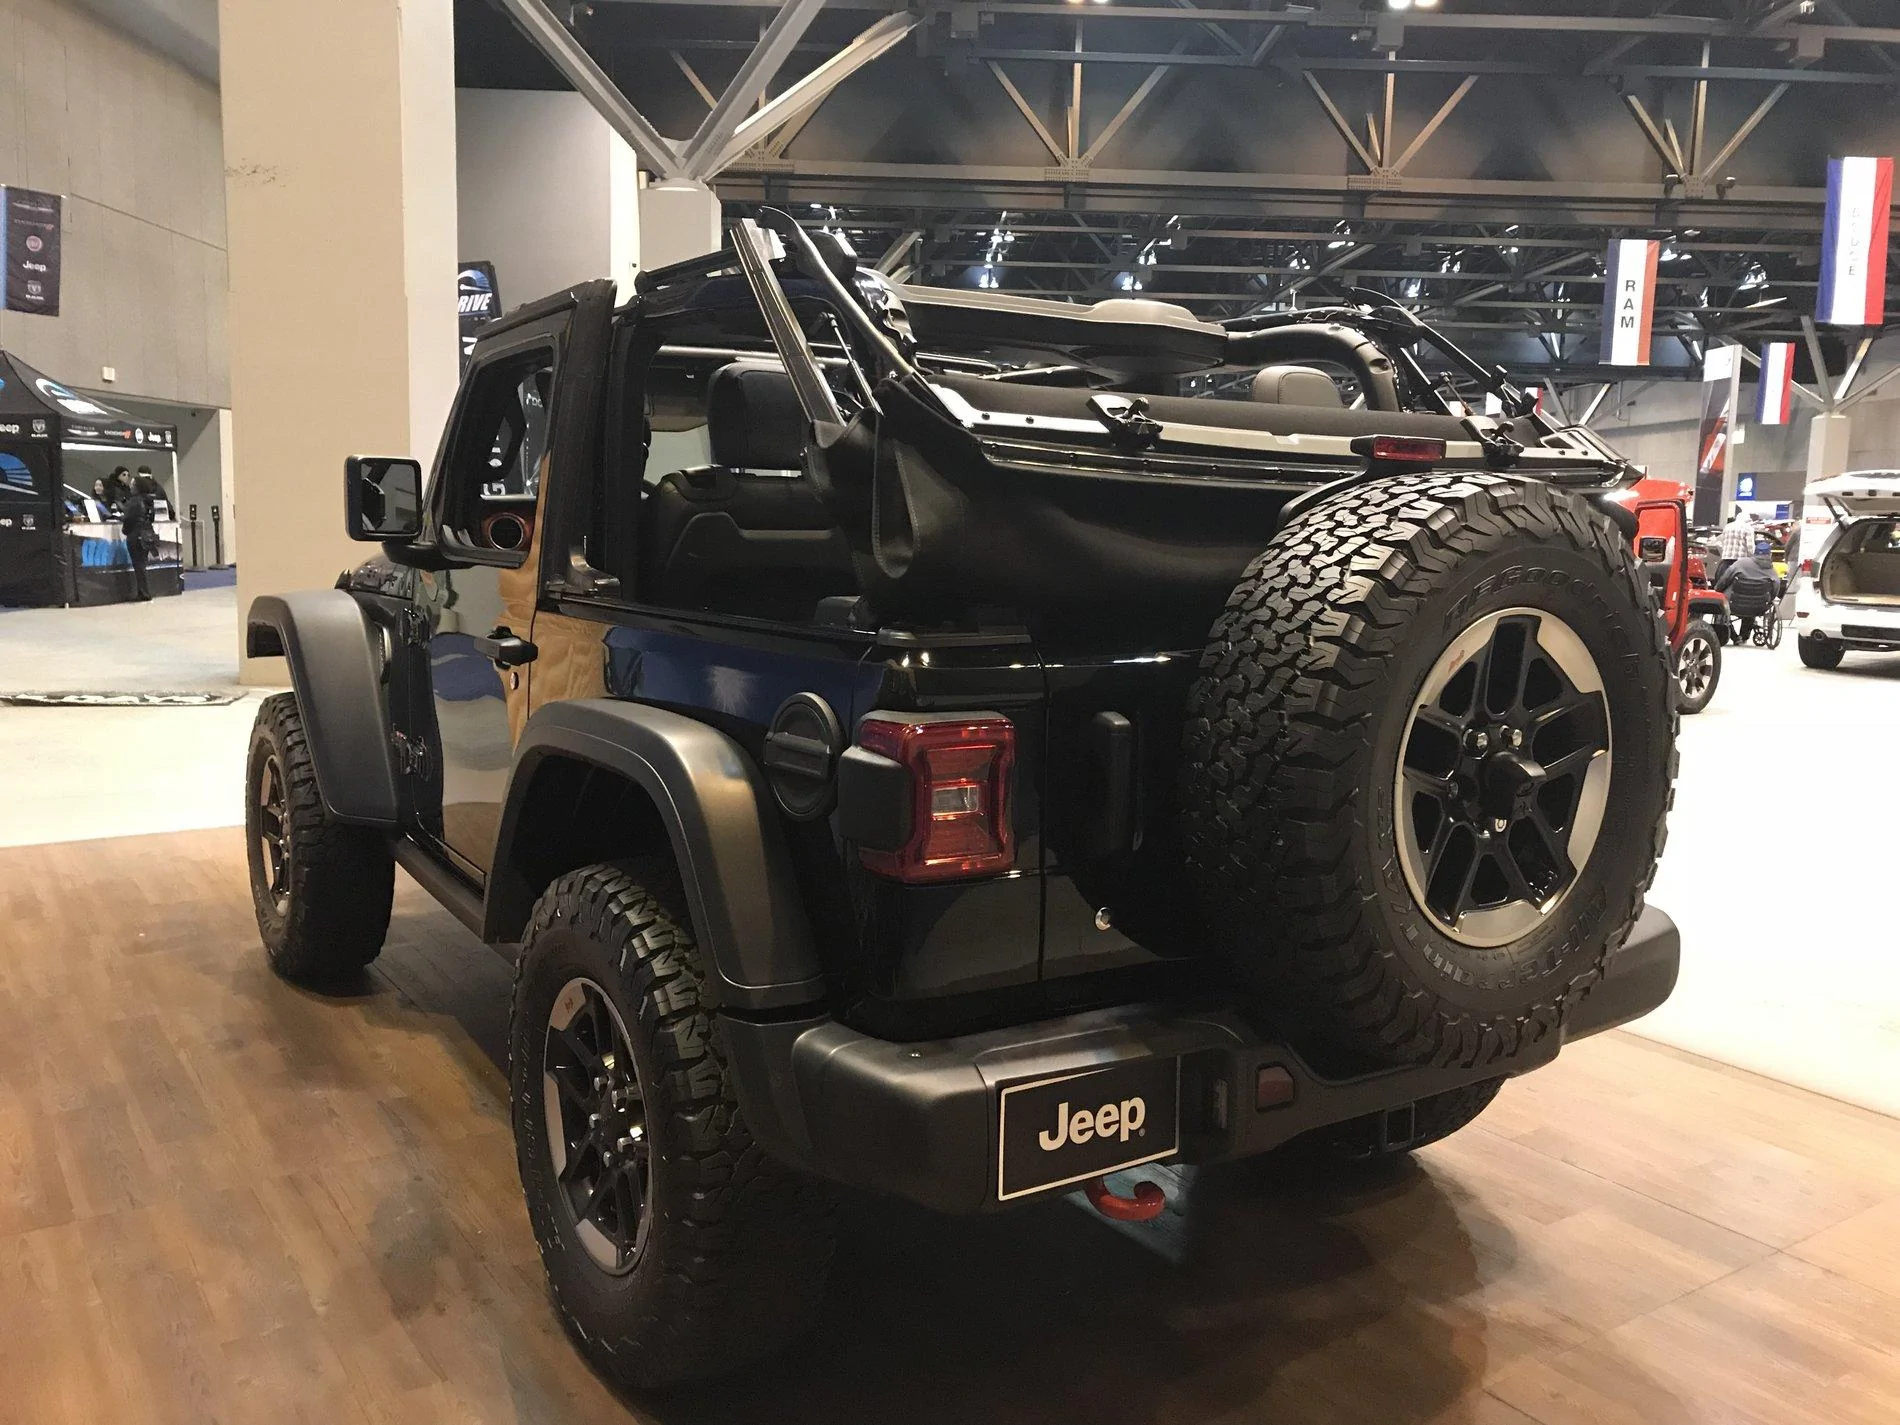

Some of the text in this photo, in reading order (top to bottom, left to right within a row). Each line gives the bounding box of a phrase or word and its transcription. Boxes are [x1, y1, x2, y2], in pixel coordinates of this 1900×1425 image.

[22, 260, 47, 272] Jeep
[458, 292, 493, 313] RIVE
[1620, 279, 1636, 329] RAM
[1039, 1097, 1146, 1152] Jeep
